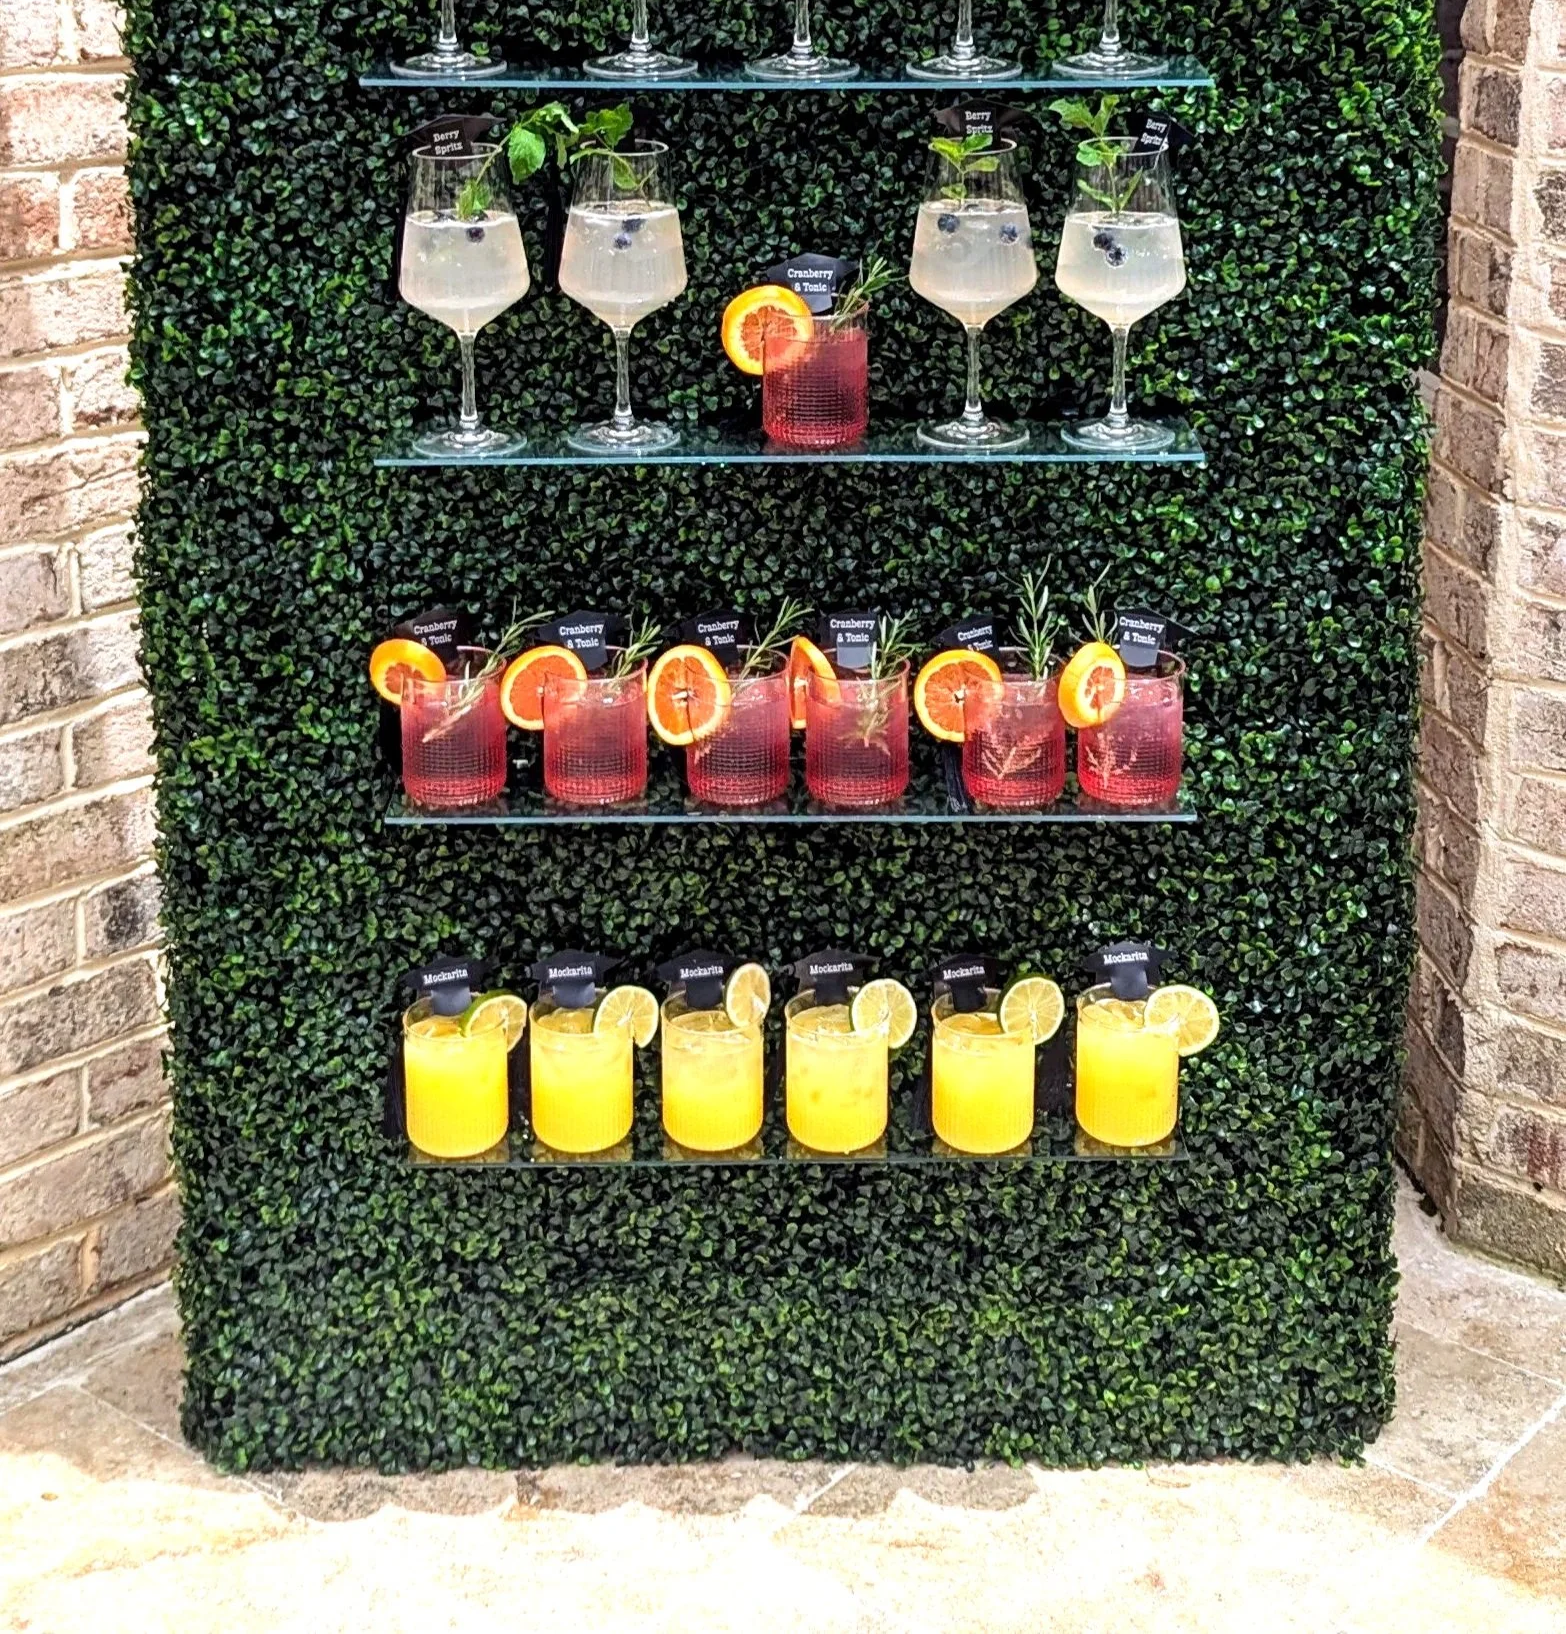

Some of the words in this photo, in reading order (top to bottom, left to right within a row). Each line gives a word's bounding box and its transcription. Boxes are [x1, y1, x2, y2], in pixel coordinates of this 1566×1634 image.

[965, 110, 991, 121] Berry
[966, 124, 993, 136] Spritz
[1146, 118, 1167, 133] Berry
[433, 129, 460, 143] Berry
[434, 141, 463, 156] Spritz
[787, 268, 833, 281] Cranberry
[803, 281, 828, 292] Tonic
[414, 619, 458, 635] Cranberry
[559, 624, 604, 636] Cranberry
[697, 620, 739, 633] Cranberry
[830, 618, 875, 631] Cranberry
[1119, 616, 1164, 634] Cranberry
[429, 633, 452, 646] Tonic
[575, 638, 599, 649] Tonic
[712, 633, 735, 646] Tonic
[846, 631, 870, 643] Tonic
[1131, 632, 1156, 645] Tonic
[1103, 950, 1150, 965] Mockarita
[548, 966, 594, 979] Mockarita
[680, 965, 724, 979] Mockarita
[809, 960, 854, 974] Mockarita
[942, 964, 985, 980] Mockarita
[423, 968, 468, 985] Mockarita
